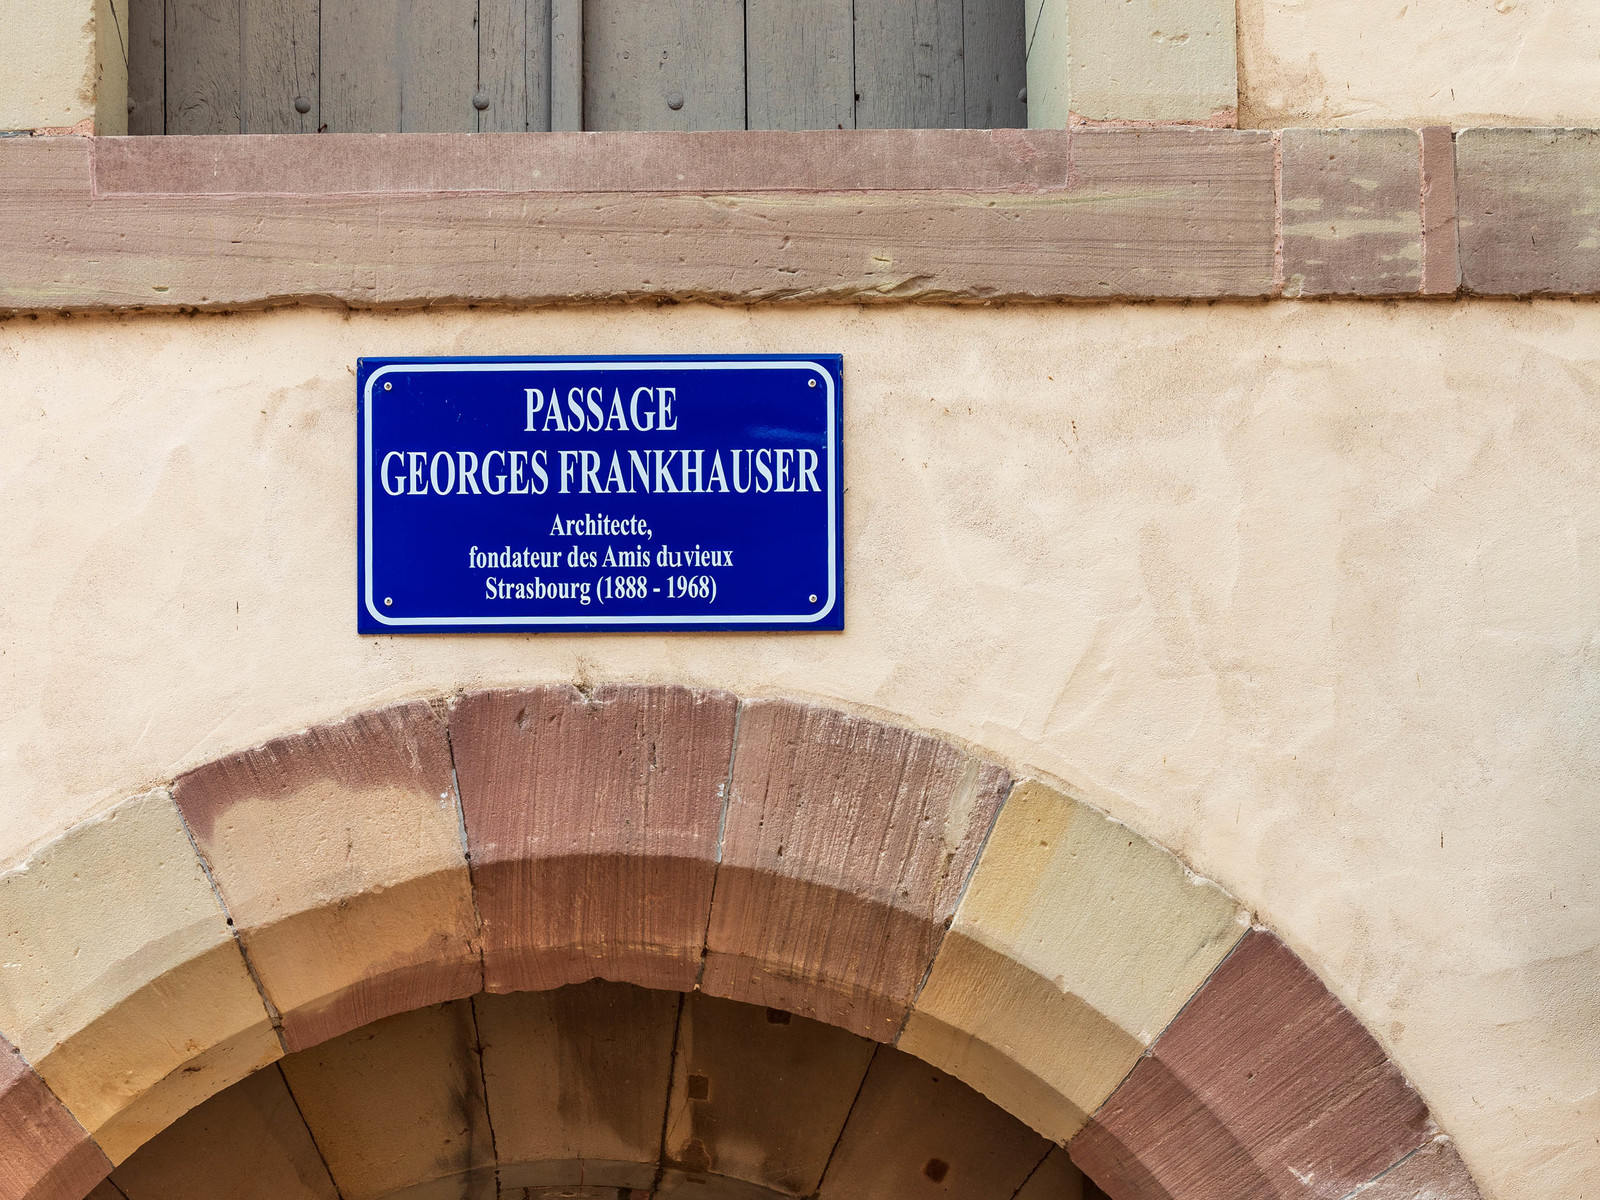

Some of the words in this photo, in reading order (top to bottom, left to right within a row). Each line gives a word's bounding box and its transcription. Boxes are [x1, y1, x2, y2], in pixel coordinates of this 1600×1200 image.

[523, 387, 678, 432] PASSAGE
[380, 450, 549, 496] GEORGES
[558, 447, 822, 494] FRANKHAUSER
[549, 513, 653, 540] Architecte,
[468, 545, 563, 569] fondateur
[567, 545, 598, 568] des
[602, 544, 651, 568] Amis
[485, 576, 591, 605] Strasbourg
[596, 575, 648, 604] (1888
[666, 575, 718, 604] 1968)
